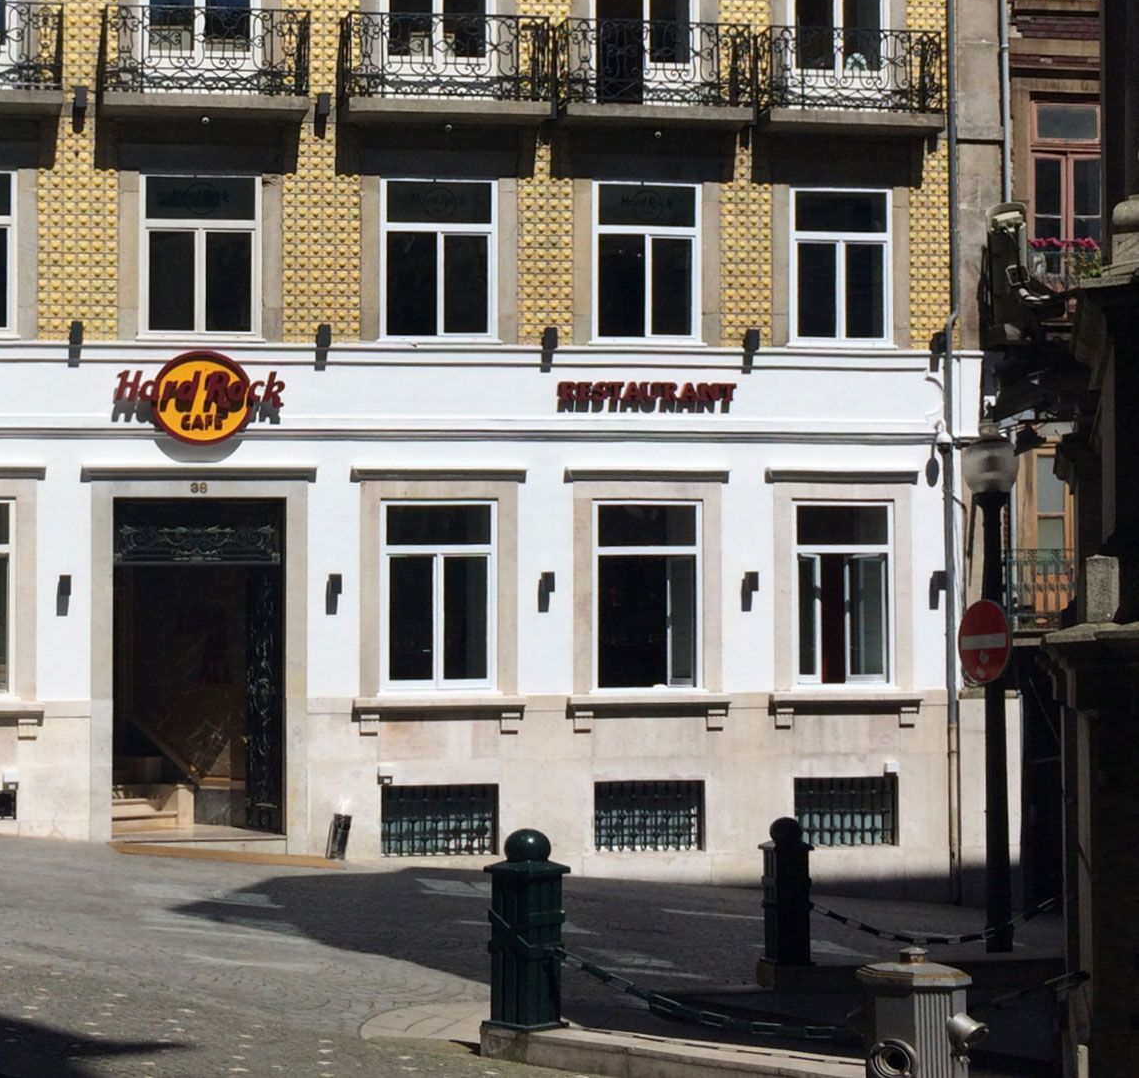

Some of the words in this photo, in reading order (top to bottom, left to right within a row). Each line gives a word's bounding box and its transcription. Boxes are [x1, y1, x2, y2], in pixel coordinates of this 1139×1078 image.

[115, 369, 202, 403] Hard
[204, 370, 286, 409] Rock
[556, 381, 737, 402] RESTAURANT
[180, 413, 224, 431] CAFE
[190, 482, 209, 494] 38
